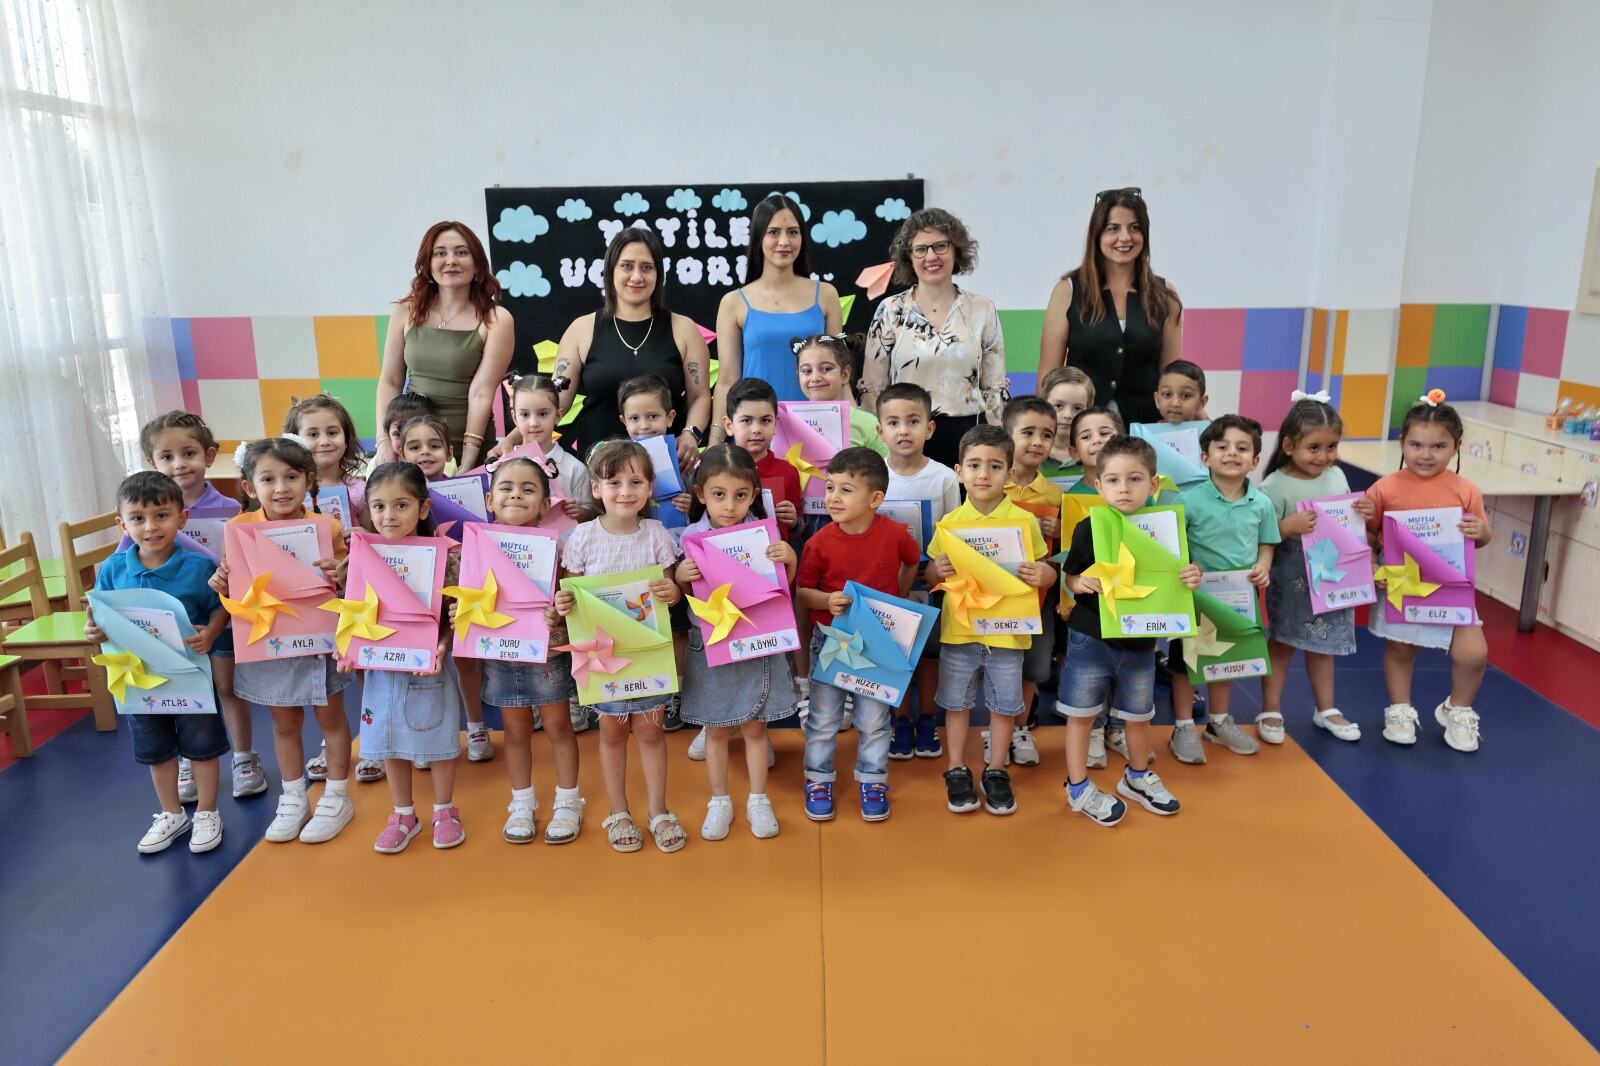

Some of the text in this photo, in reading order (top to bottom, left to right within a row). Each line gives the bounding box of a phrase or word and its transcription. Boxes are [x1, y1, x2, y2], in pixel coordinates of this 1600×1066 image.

[500, 541, 529, 552] MUTLU
[870, 607, 892, 620] UTLU
[1428, 609, 1447, 619] ELİZ
[994, 620, 1019, 630] DENİZ
[1146, 619, 1167, 631] ERİM
[292, 638, 314, 649] AYLA
[499, 638, 520, 648] DURU
[383, 651, 406, 662] AZRA
[1222, 663, 1247, 673] YUSUF
[624, 680, 649, 692] BERİL
[161, 699, 188, 707] ATLAS
